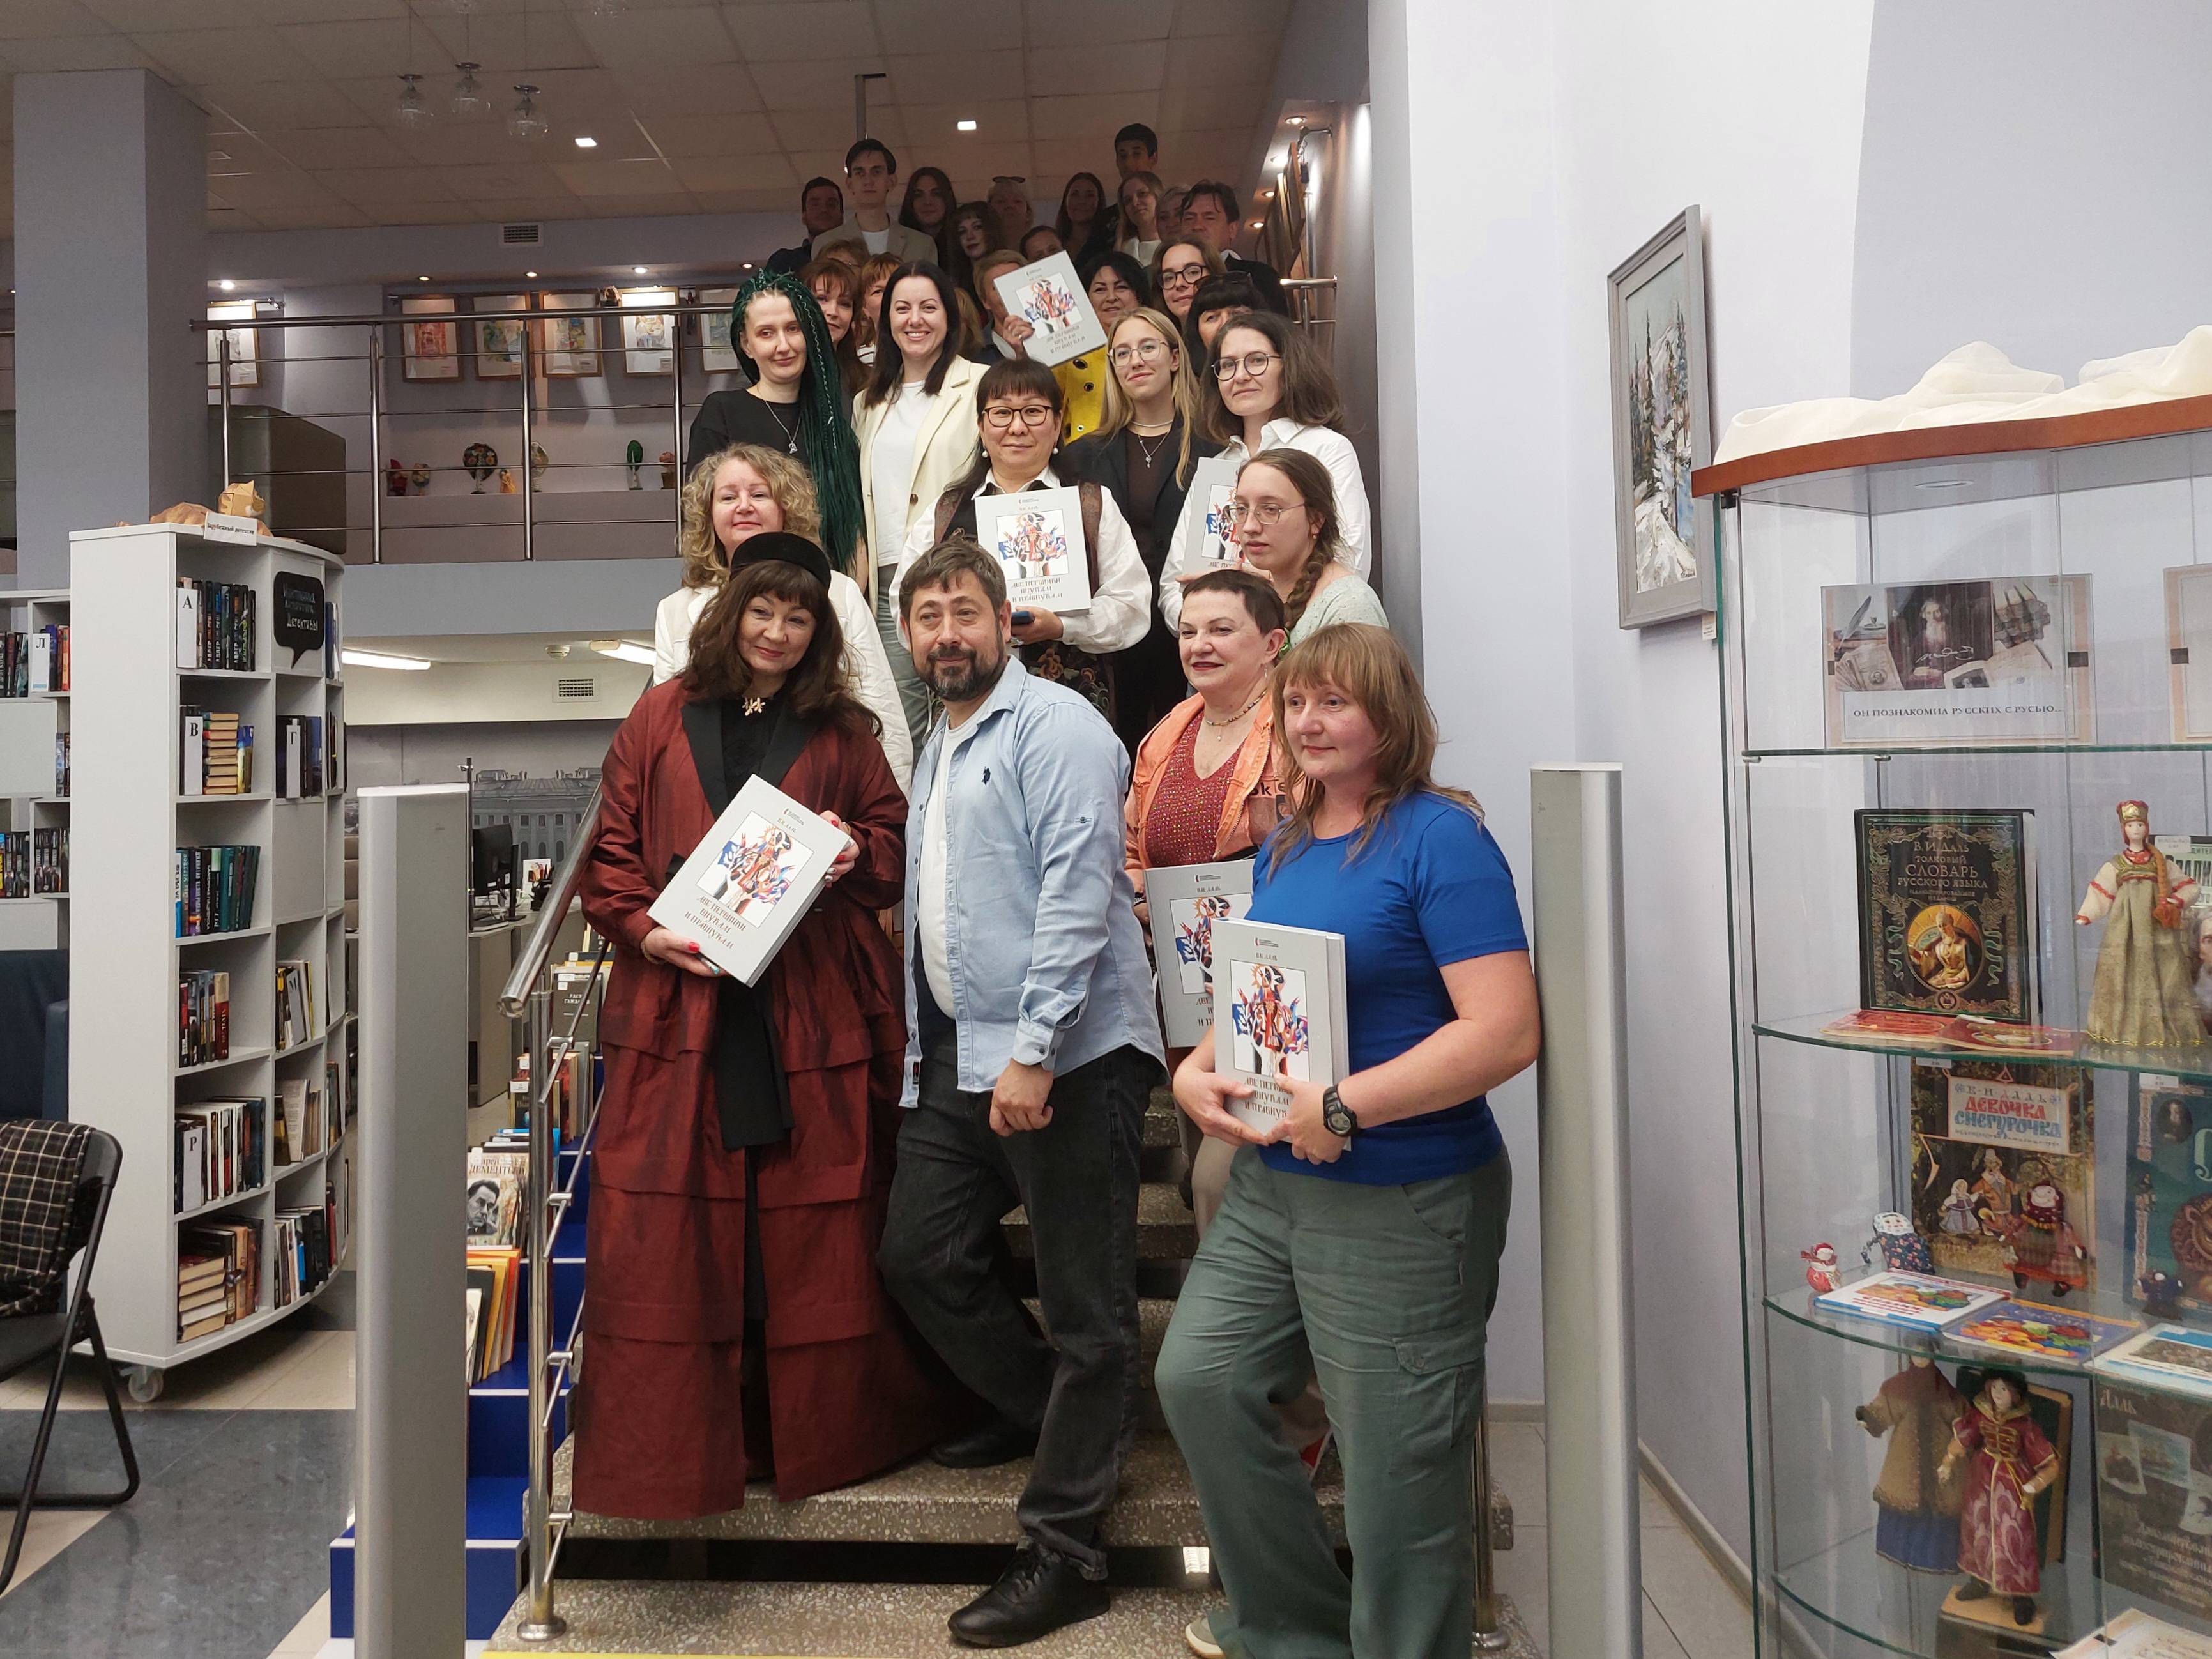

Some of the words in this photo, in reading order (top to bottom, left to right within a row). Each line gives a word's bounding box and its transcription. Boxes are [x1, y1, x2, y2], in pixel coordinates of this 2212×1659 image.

[182, 595, 194, 609] А
[35, 638, 46, 649] Л
[1952, 707, 2002, 715] РУССКИХ
[190, 722, 199, 737] В
[290, 731, 298, 745] Г
[1915, 855, 1967, 864] ТОЛКОВЫЙ
[1905, 864, 1979, 878] СЛОВАРЬ
[1898, 877, 1950, 887] РУССКОГО
[1952, 880, 1988, 889] ЯЗЫКА
[1252, 1103, 1287, 1120] ПРАВНУК
[1965, 1096, 2047, 1120] ДЕВОЧКА
[1954, 1110, 2063, 1140] СНЕГУРОЧКА
